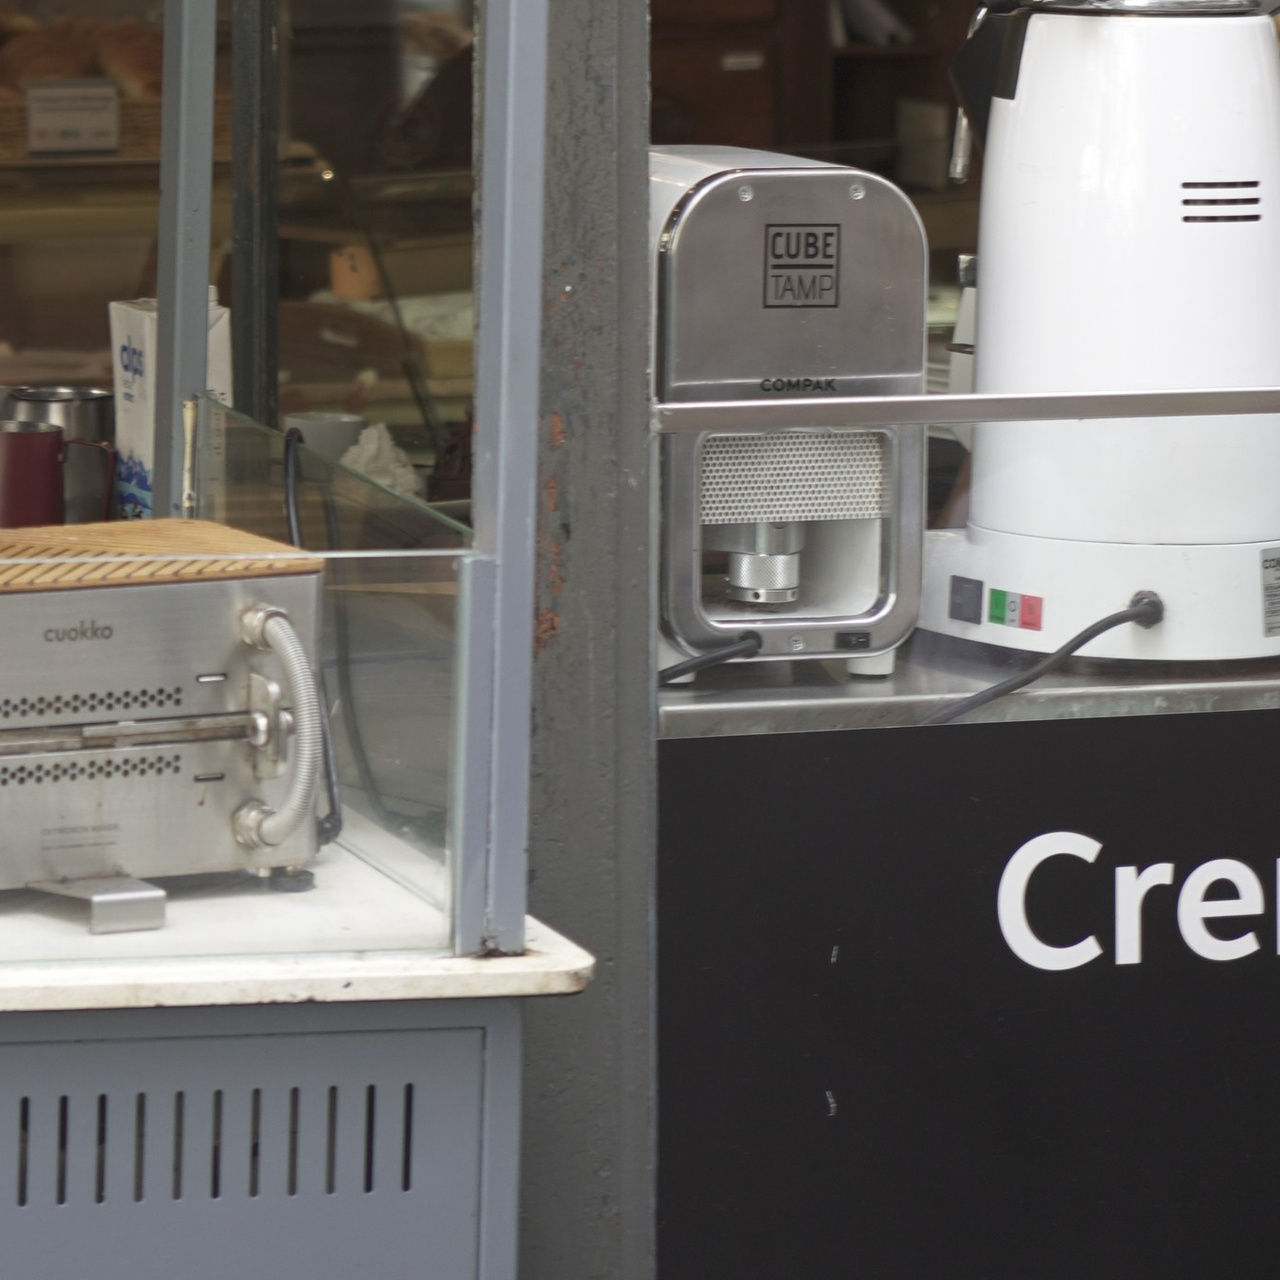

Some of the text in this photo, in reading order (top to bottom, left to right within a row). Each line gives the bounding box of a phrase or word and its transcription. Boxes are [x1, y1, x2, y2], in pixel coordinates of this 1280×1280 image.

[771, 231, 834, 260] CUBE
[770, 274, 834, 301] TAMP
[760, 378, 837, 393] COMPAK
[43, 619, 114, 643] cuokko
[997, 830, 1280, 972] Cre
